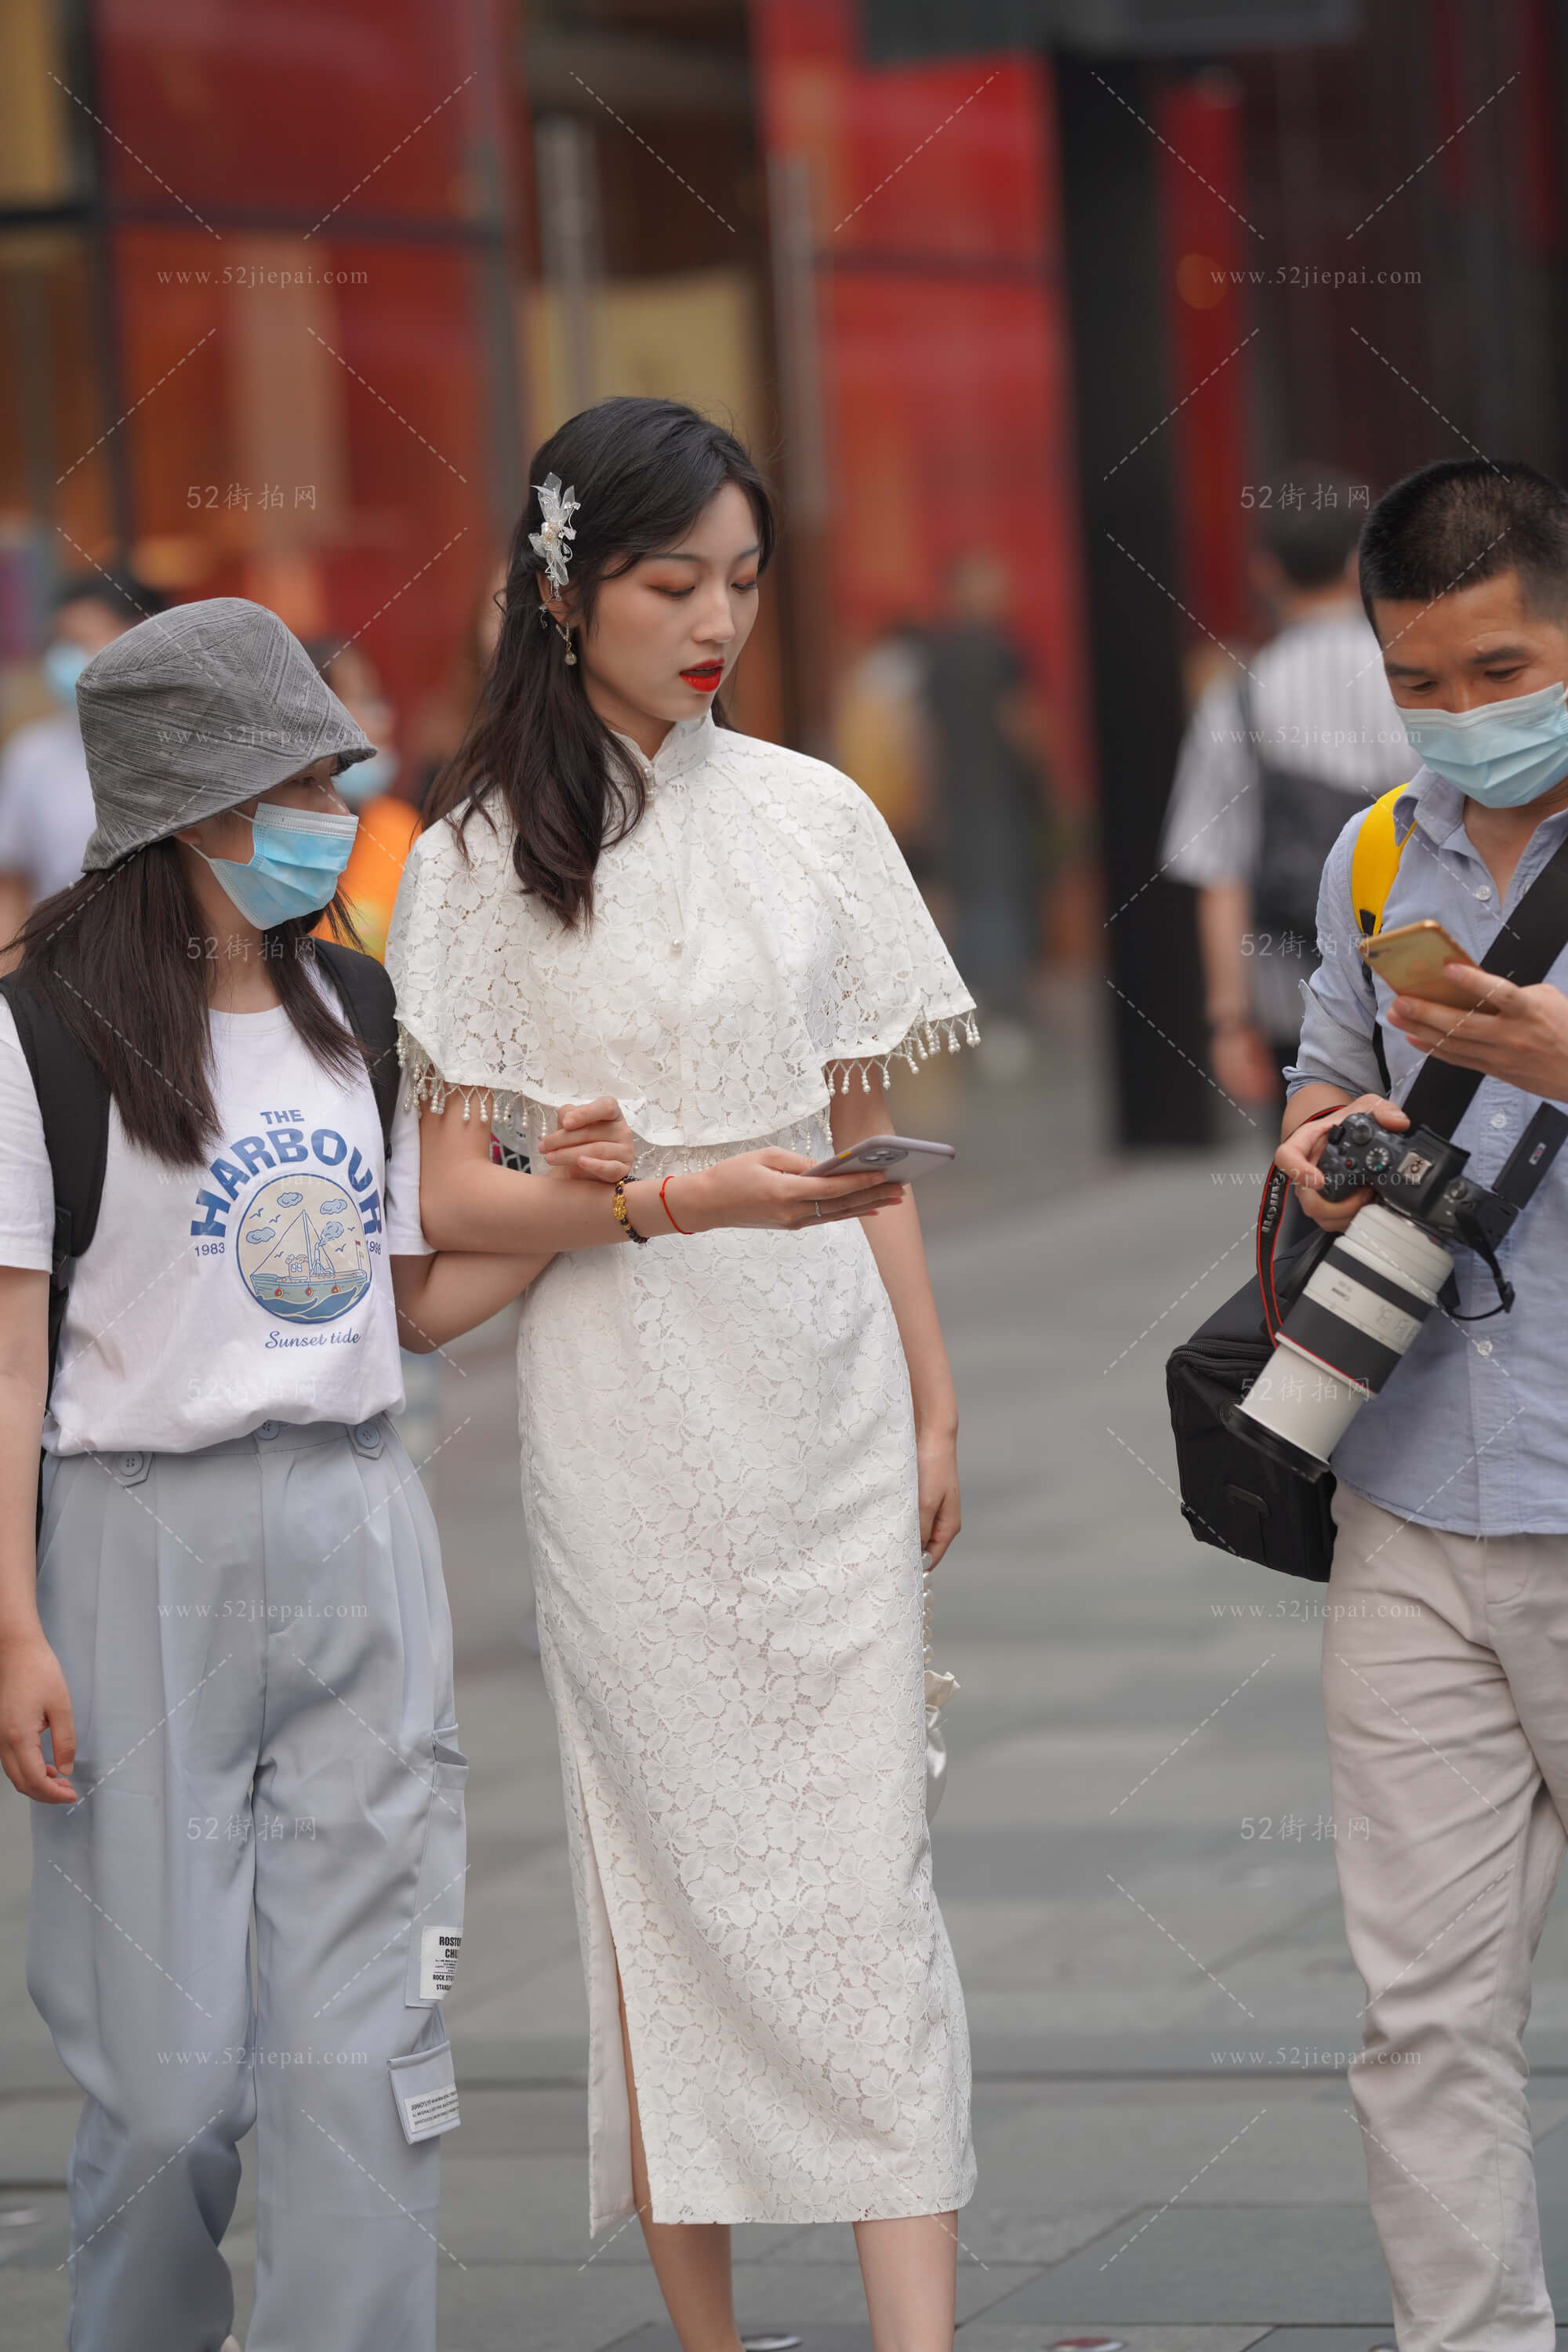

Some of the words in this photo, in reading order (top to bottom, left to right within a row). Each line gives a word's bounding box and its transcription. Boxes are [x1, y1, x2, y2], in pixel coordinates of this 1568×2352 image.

[260, 1109, 304, 1124] THE
[191, 1127, 382, 1237] HARBOUR
[194, 1242, 226, 1258] 1983
[265, 1330, 328, 1348] Sunset
[329, 1327, 361, 1345] tide
